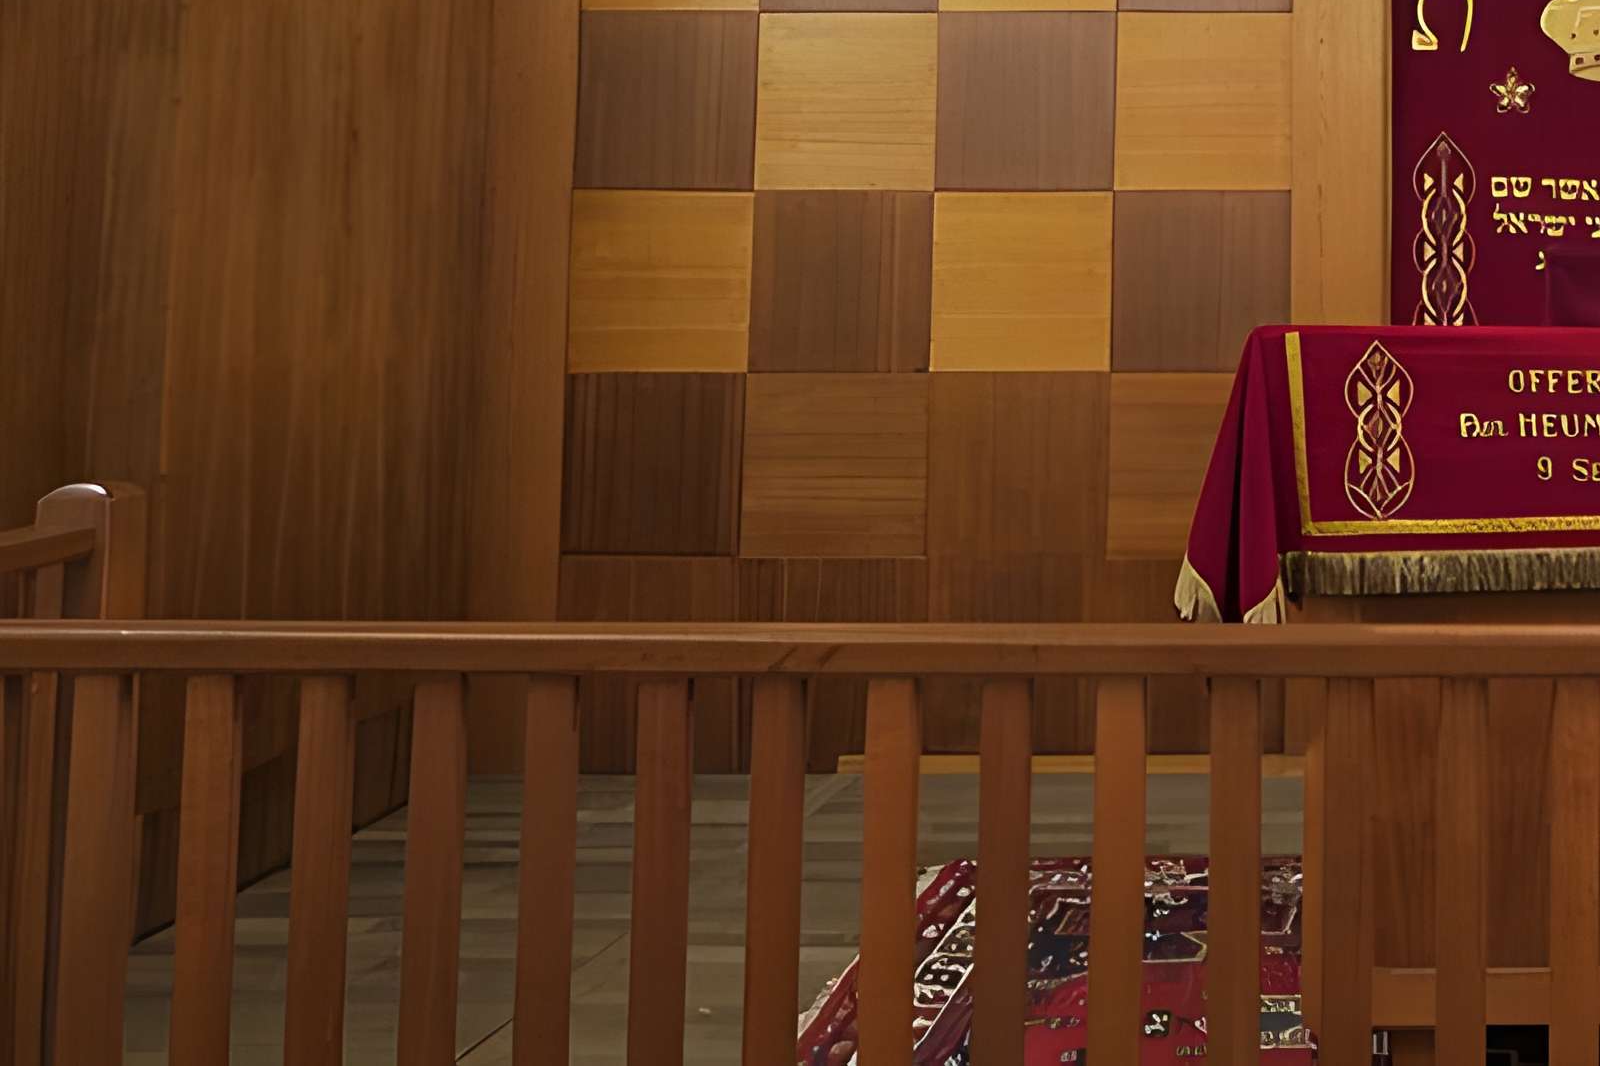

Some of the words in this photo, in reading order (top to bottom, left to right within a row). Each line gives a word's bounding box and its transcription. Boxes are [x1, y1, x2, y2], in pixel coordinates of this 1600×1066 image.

[1490, 176, 1532, 198] שם
[1541, 178, 1600, 201] אשר
[1492, 202, 1576, 237] ישראל
[1536, 456, 1553, 481] 9
